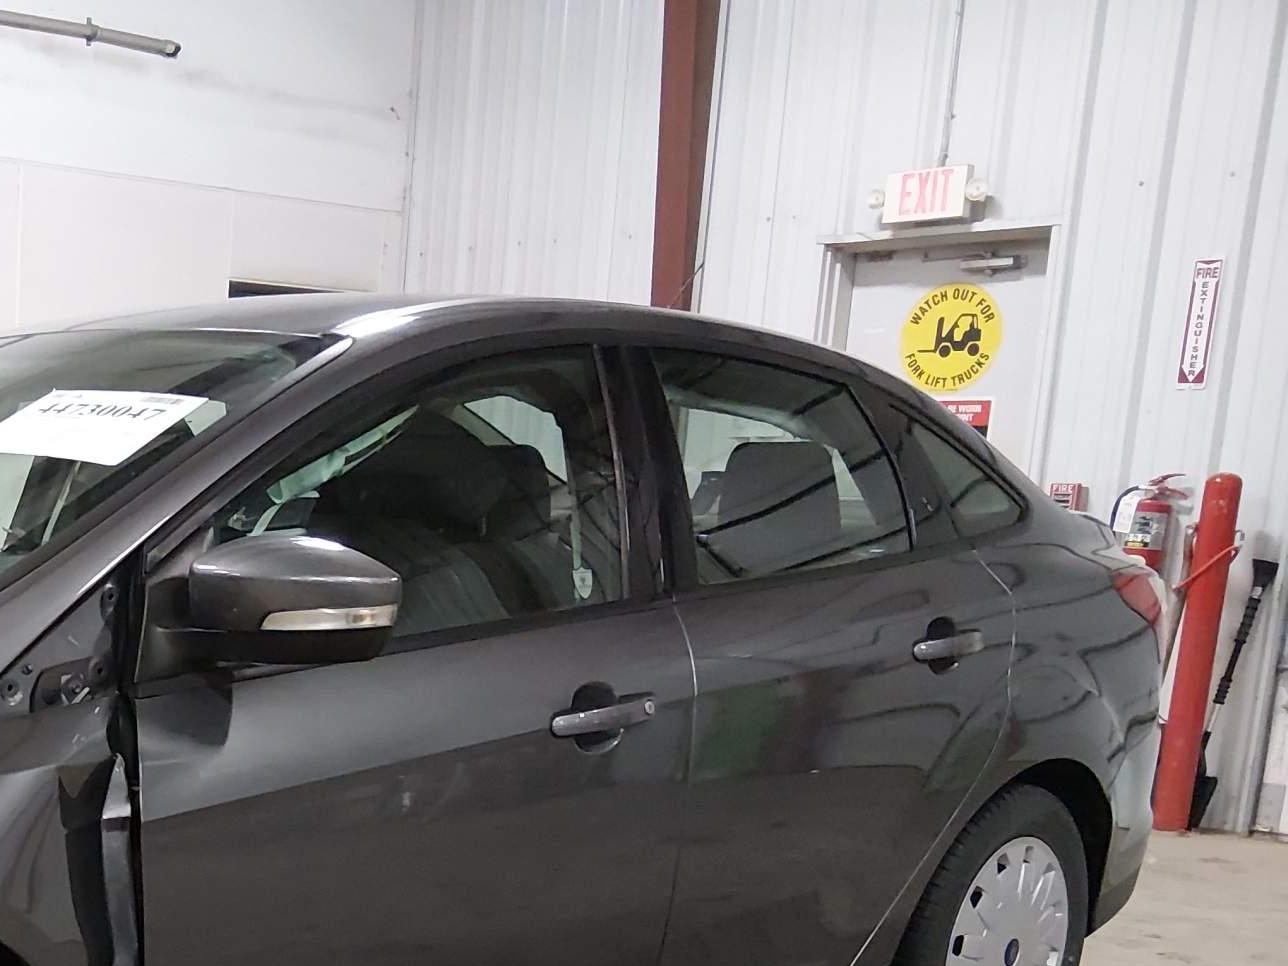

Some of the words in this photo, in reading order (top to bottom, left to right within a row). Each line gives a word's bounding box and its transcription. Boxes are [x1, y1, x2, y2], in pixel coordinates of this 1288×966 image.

[898, 169, 954, 216] EXIT
[1196, 267, 1219, 279] FIRE
[910, 290, 949, 326] WATCH
[952, 287, 977, 303] OUT
[975, 298, 996, 324] FOR
[1187, 281, 1210, 377] EXTINGUISHER
[904, 352, 925, 380] FORK
[925, 374, 948, 389] LIFT
[951, 352, 990, 387] TRUCKS
[39, 403, 167, 421] 44730047
[1052, 484, 1074, 494] FIRE
